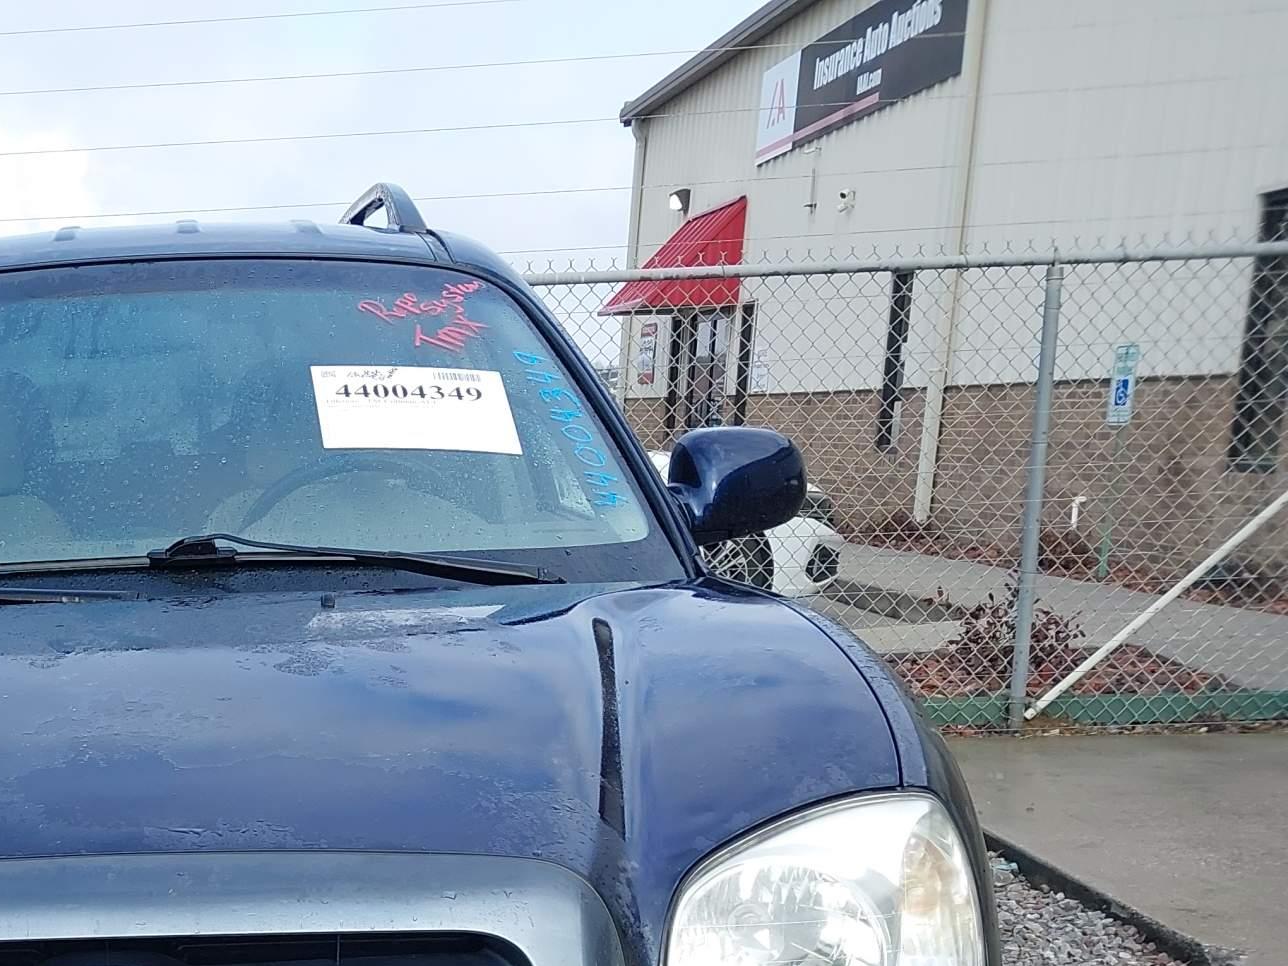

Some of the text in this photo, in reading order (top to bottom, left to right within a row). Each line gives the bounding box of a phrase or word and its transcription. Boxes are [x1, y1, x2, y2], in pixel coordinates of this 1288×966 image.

[813, 0, 942, 90] Insurance Auto Auctions
[335, 384, 483, 402] 44004349
